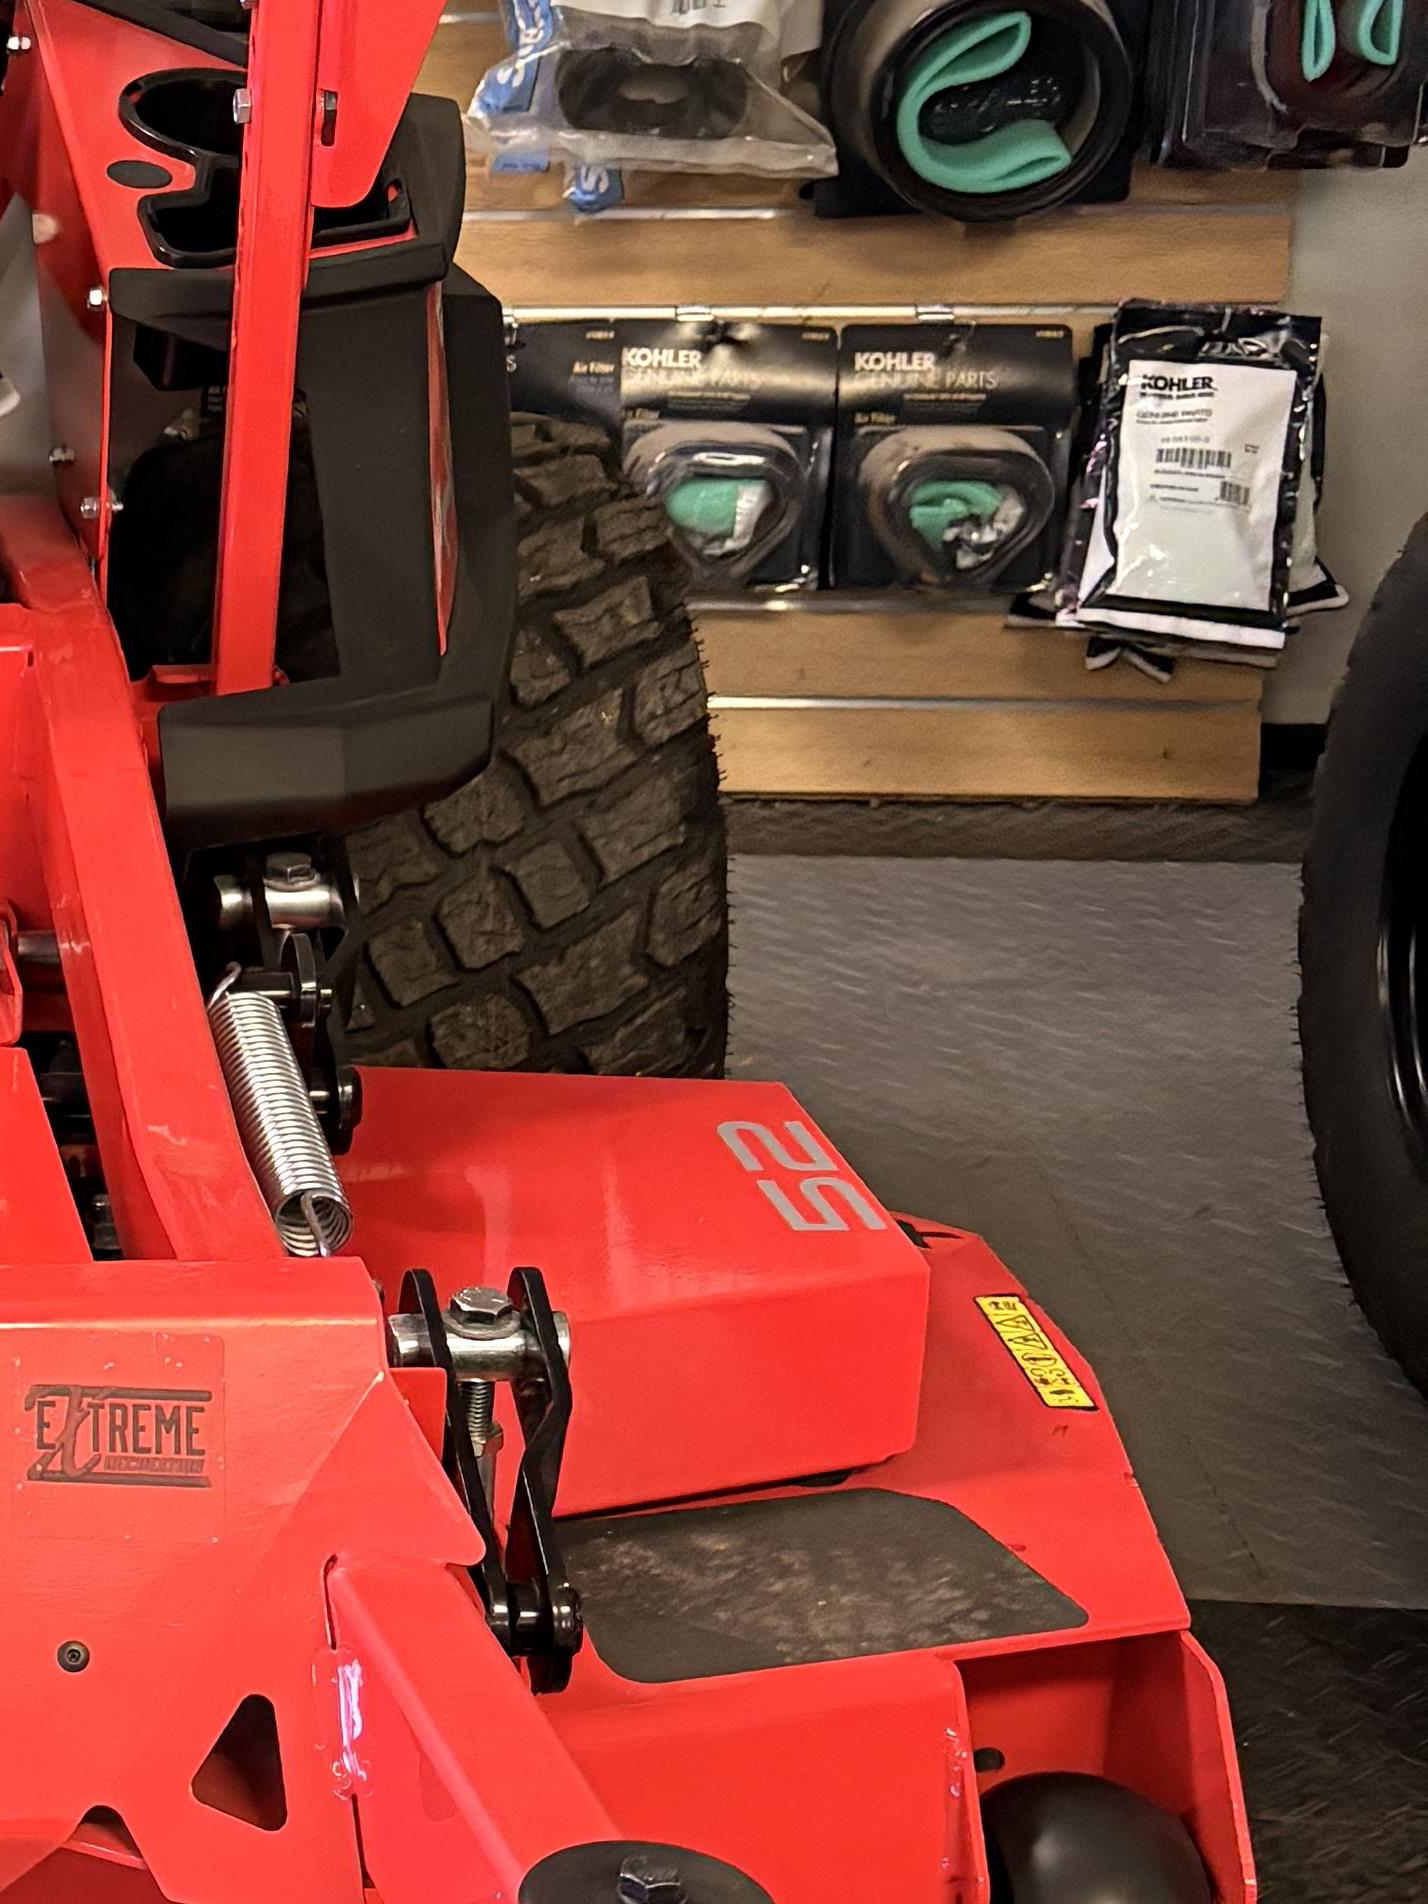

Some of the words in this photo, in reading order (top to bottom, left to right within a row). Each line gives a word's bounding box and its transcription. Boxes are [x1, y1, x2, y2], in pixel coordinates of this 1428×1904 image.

[624, 348, 703, 367] KOHLER
[855, 352, 935, 371] KOHLER
[946, 371, 998, 389] PARTS
[1142, 374, 1217, 391] KOHLER
[717, 1121, 887, 1231] 52
